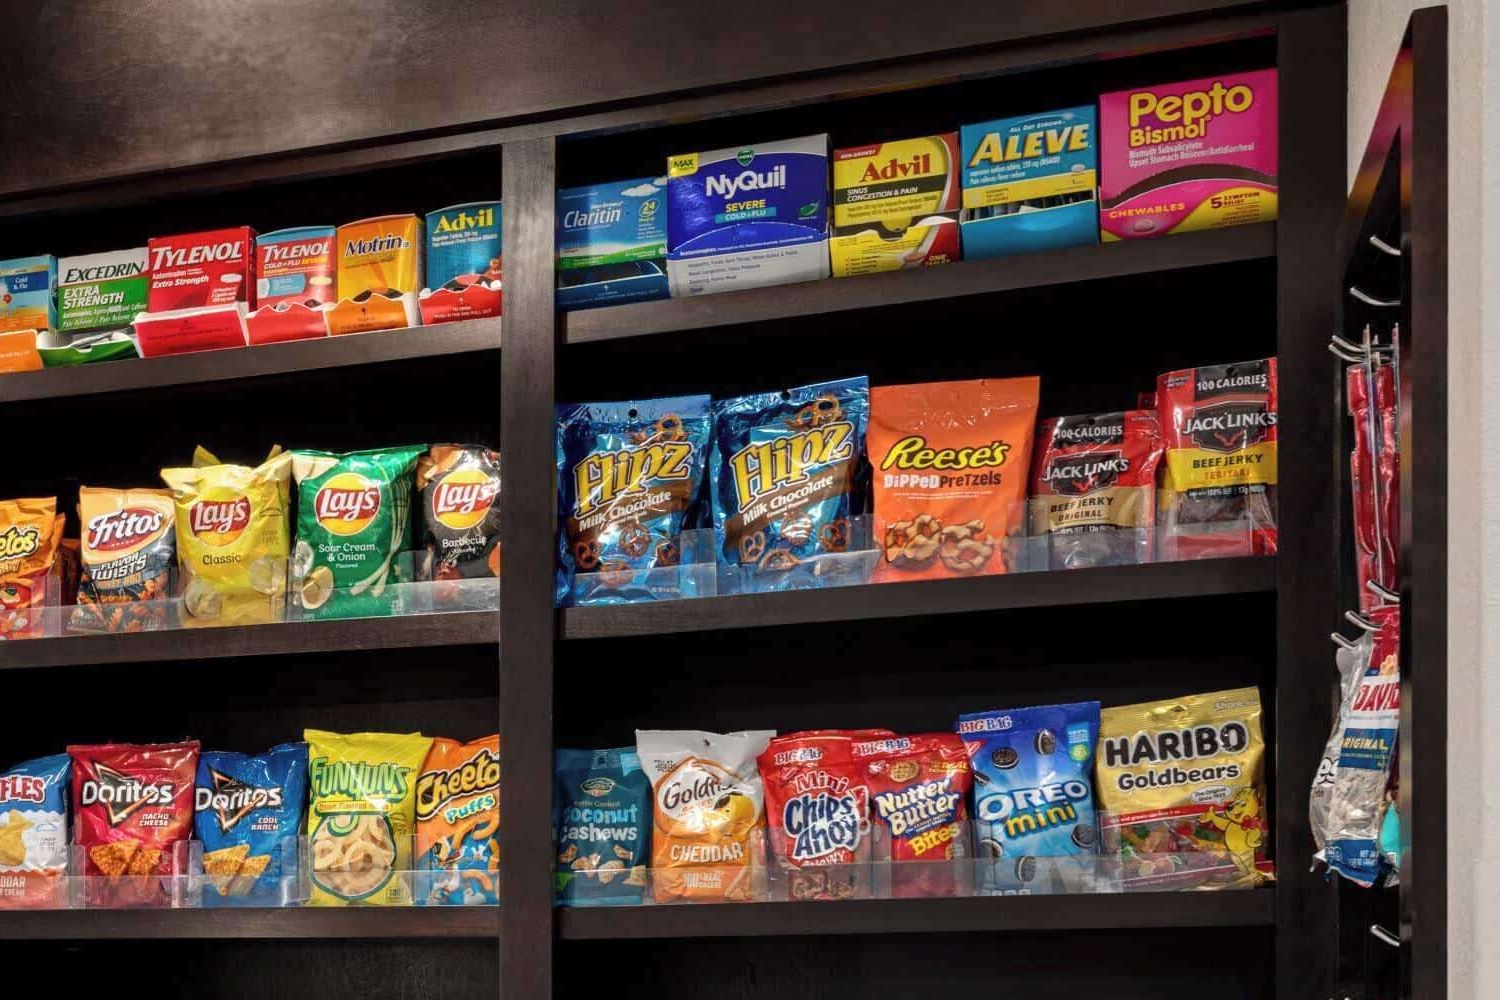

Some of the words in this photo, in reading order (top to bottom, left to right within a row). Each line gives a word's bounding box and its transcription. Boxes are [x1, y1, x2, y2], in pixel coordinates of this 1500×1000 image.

[1129, 82, 1253, 127] Pepto
[1130, 118, 1205, 147] Bismol
[968, 124, 1090, 168] ALEVE
[674, 159, 693, 168] MAX
[860, 153, 931, 182] Advil
[706, 165, 786, 199] NyQuil
[847, 186, 868, 195] SINUS
[847, 190, 892, 202] CONGESTION
[900, 186, 917, 195] PAIN
[564, 208, 621, 229] Claritin
[725, 200, 766, 212] SEVERE
[725, 212, 745, 221] COLD
[752, 209, 766, 219] FLU
[1109, 203, 1185, 218] CHEWABLES
[434, 208, 493, 234] Advil
[152, 241, 244, 270] TYLENOL
[263, 242, 330, 263] TYLENOL
[345, 232, 403, 257] Motrin
[64, 261, 145, 284] EXCEDRIN
[152, 277, 173, 289] Extra
[175, 276, 209, 286] Strength
[63, 293, 124, 309] STRENGTH
[64, 285, 100, 299] EXTRA
[1197, 381, 1214, 391] 100
[1216, 373, 1267, 389] CALORIES
[1183, 415, 1224, 434] JACK
[1227, 412, 1277, 427] LINK'S
[881, 435, 1011, 471] Reese's
[1193, 457, 1222, 469] BEEF
[1223, 453, 1264, 467] JERKY
[730, 421, 854, 514] Flipz
[1039, 464, 1080, 481] JACK
[1084, 458, 1129, 476] LINK'S
[573, 441, 693, 522] Flipz
[319, 486, 377, 521] Lay's
[743, 502, 768, 526] Milk
[771, 474, 834, 508] Chocolate
[1051, 501, 1076, 513] BEEF
[1077, 496, 1114, 510] JERKY
[194, 497, 249, 533] Lay's
[1058, 509, 1102, 522] ORIGINAL
[88, 508, 163, 550] Fritos
[202, 552, 242, 566] Classic
[319, 543, 341, 553] Sour
[343, 542, 375, 553] Cream
[327, 553, 336, 562] &
[337, 551, 365, 561] Onion
[1105, 721, 1248, 767] HARIBO
[416, 750, 500, 816] Cheeto
[795, 771, 849, 793] Mini
[1117, 764, 1241, 791] Goldbears
[82, 781, 174, 806] Doritos
[194, 786, 282, 811] Doritos
[874, 776, 951, 817] Nutter
[976, 780, 1088, 821] OREO
[446, 793, 496, 824] Puffs
[888, 792, 960, 836] Butter
[1005, 801, 1077, 838] mini
[908, 823, 960, 856] Bites
[670, 842, 744, 863] CHEDDAR
